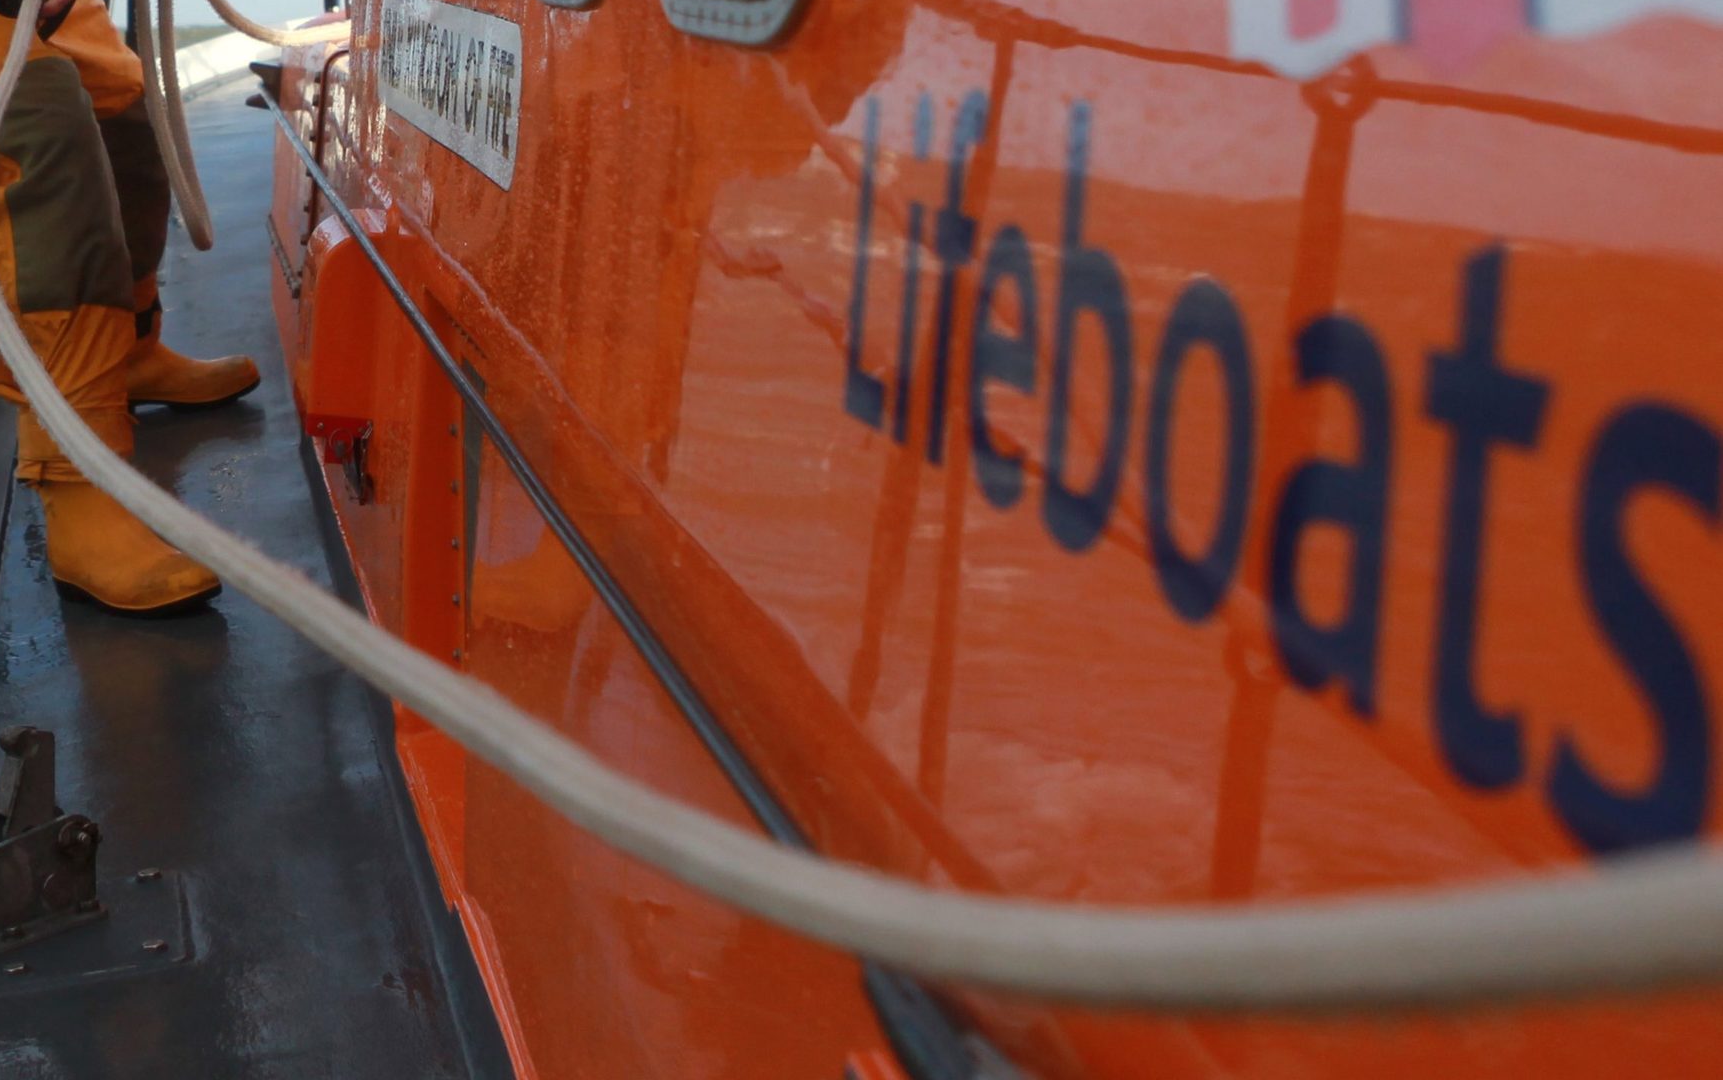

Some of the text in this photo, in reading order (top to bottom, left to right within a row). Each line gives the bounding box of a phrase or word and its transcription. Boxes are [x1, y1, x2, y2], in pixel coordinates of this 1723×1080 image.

[464, 37, 485, 137] OF
[484, 44, 515, 160] FIFE
[844, 88, 1723, 863] Lifeboats
